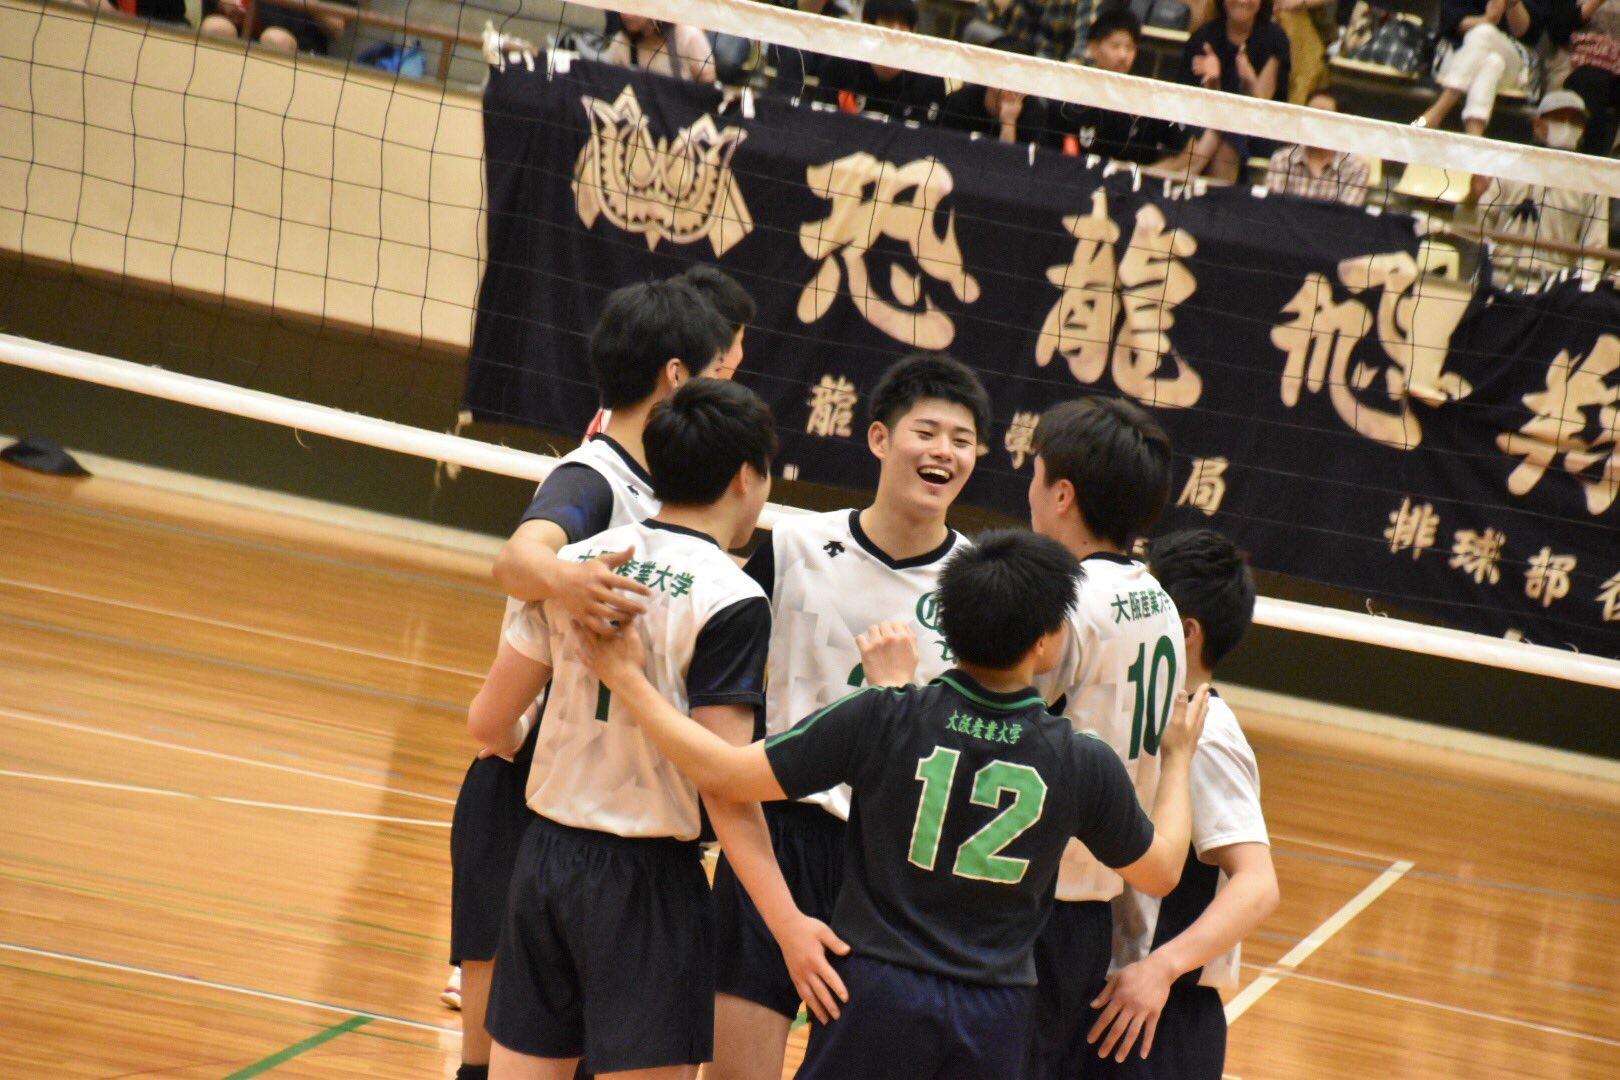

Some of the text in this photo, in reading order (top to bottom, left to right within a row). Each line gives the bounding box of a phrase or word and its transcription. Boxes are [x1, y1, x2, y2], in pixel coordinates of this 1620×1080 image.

[945, 709, 1024, 745] 大阪産業大学
[1127, 635, 1177, 761] 10
[907, 745, 1048, 885] 12
